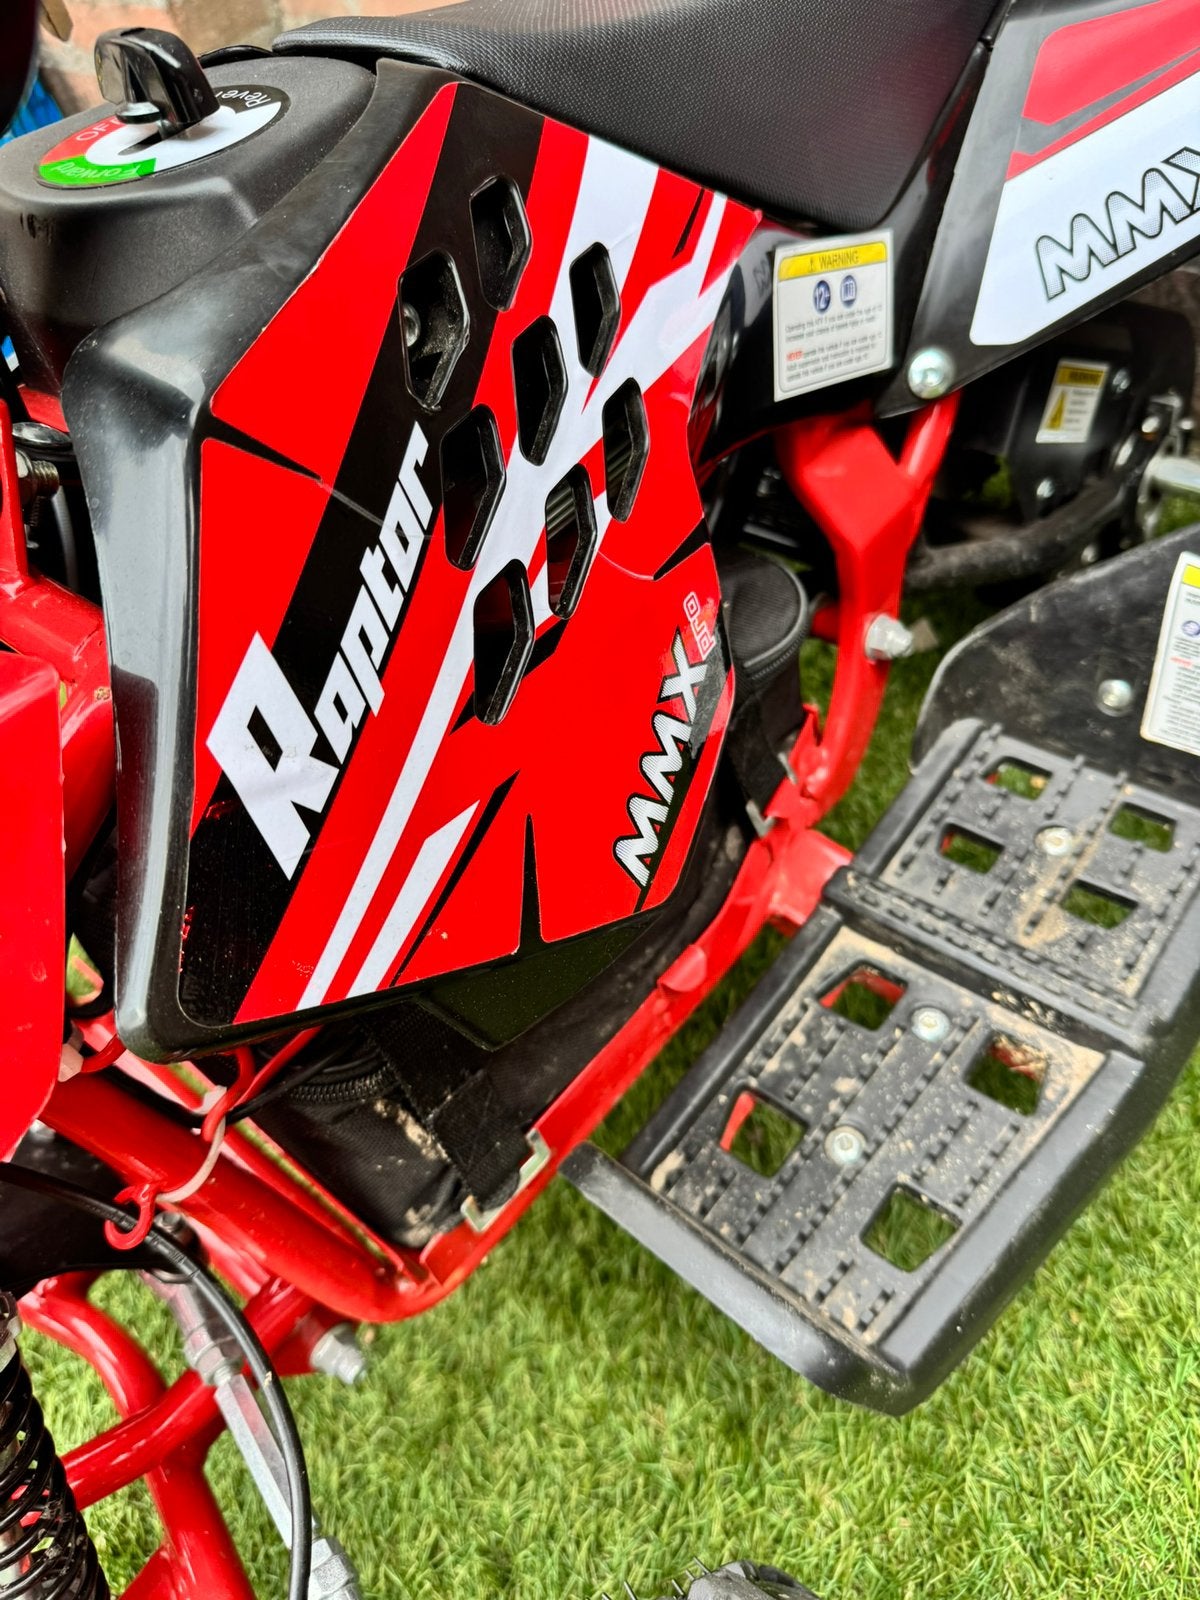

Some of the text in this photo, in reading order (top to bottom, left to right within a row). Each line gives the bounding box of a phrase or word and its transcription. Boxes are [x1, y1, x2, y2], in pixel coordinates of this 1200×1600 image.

[50, 162, 141, 180] Forward
[818, 250, 860, 271] WARNING
[206, 420, 433, 881] Raptor
[612, 626, 708, 890] MMX
